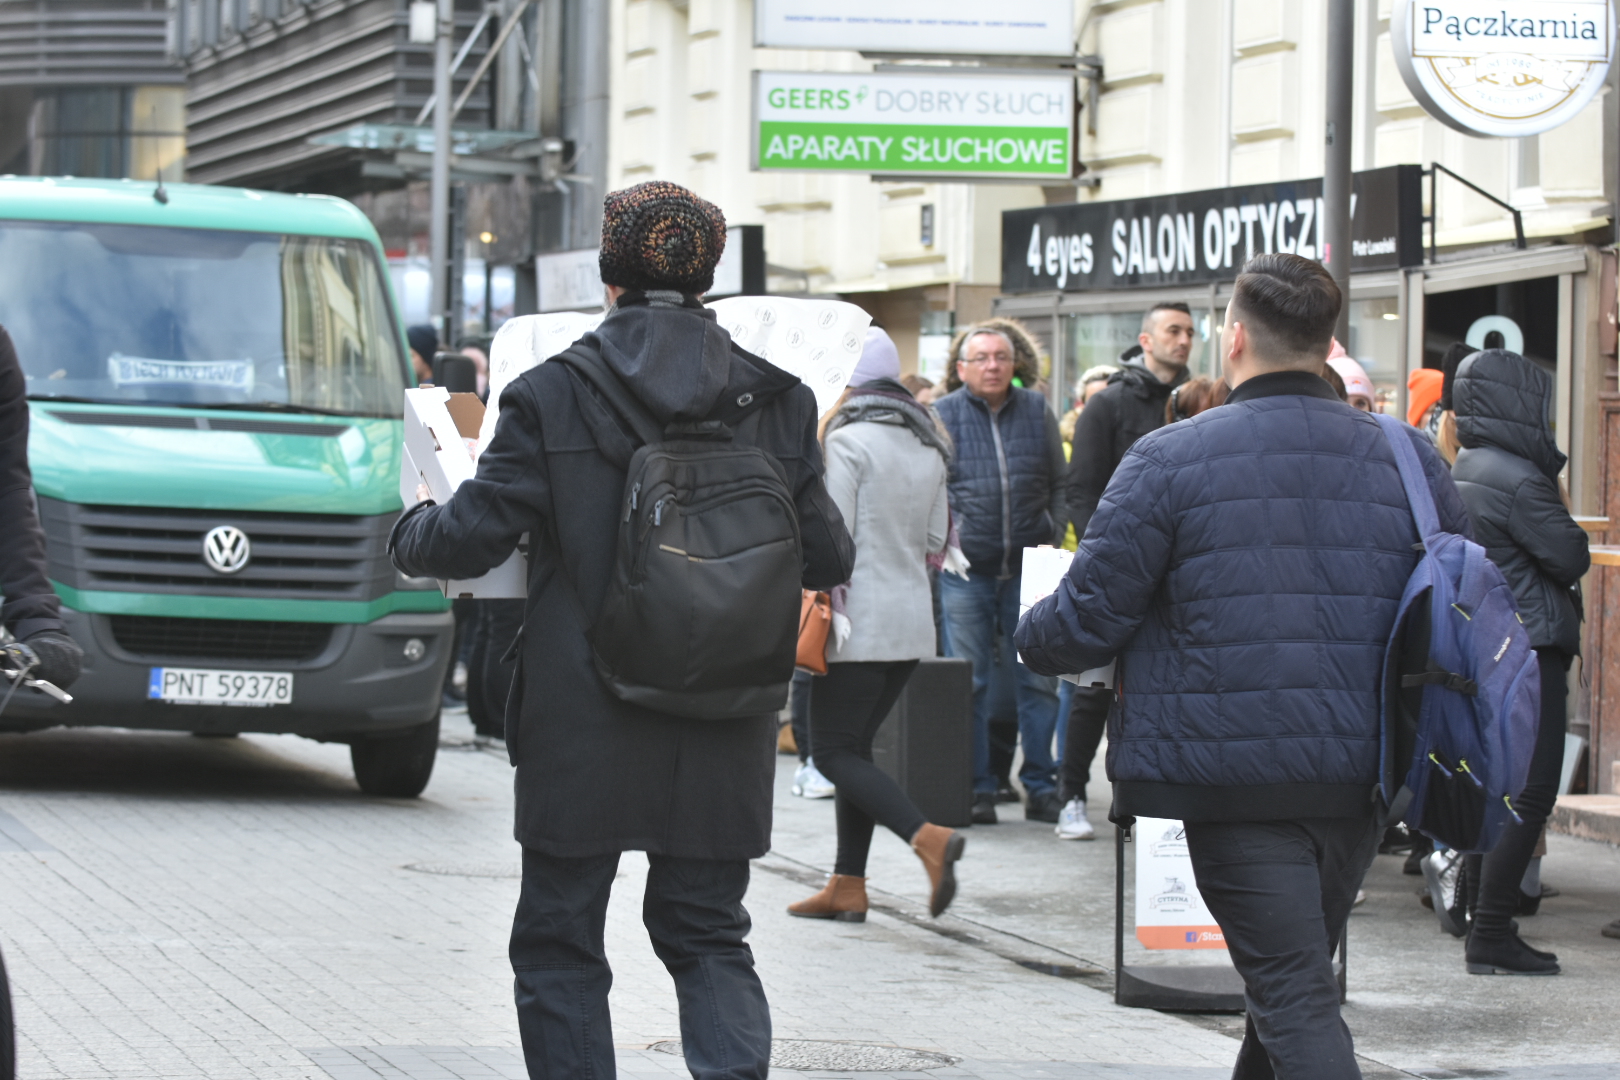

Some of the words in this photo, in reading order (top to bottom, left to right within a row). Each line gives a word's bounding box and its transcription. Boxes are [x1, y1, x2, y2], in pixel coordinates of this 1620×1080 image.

[1423, 7, 1598, 41] Pączkarnia
[768, 87, 850, 110] GEERS
[875, 89, 970, 113] DOBRY
[976, 91, 1065, 115] SŁUCH
[764, 134, 894, 162] APARATY
[901, 136, 1065, 165] SŁUCHOWE
[1027, 223, 1042, 276] 4
[1045, 232, 1094, 289] eyes
[1112, 211, 1196, 276] SALON
[164, 671, 209, 697] PNT
[218, 674, 289, 700] 59378
